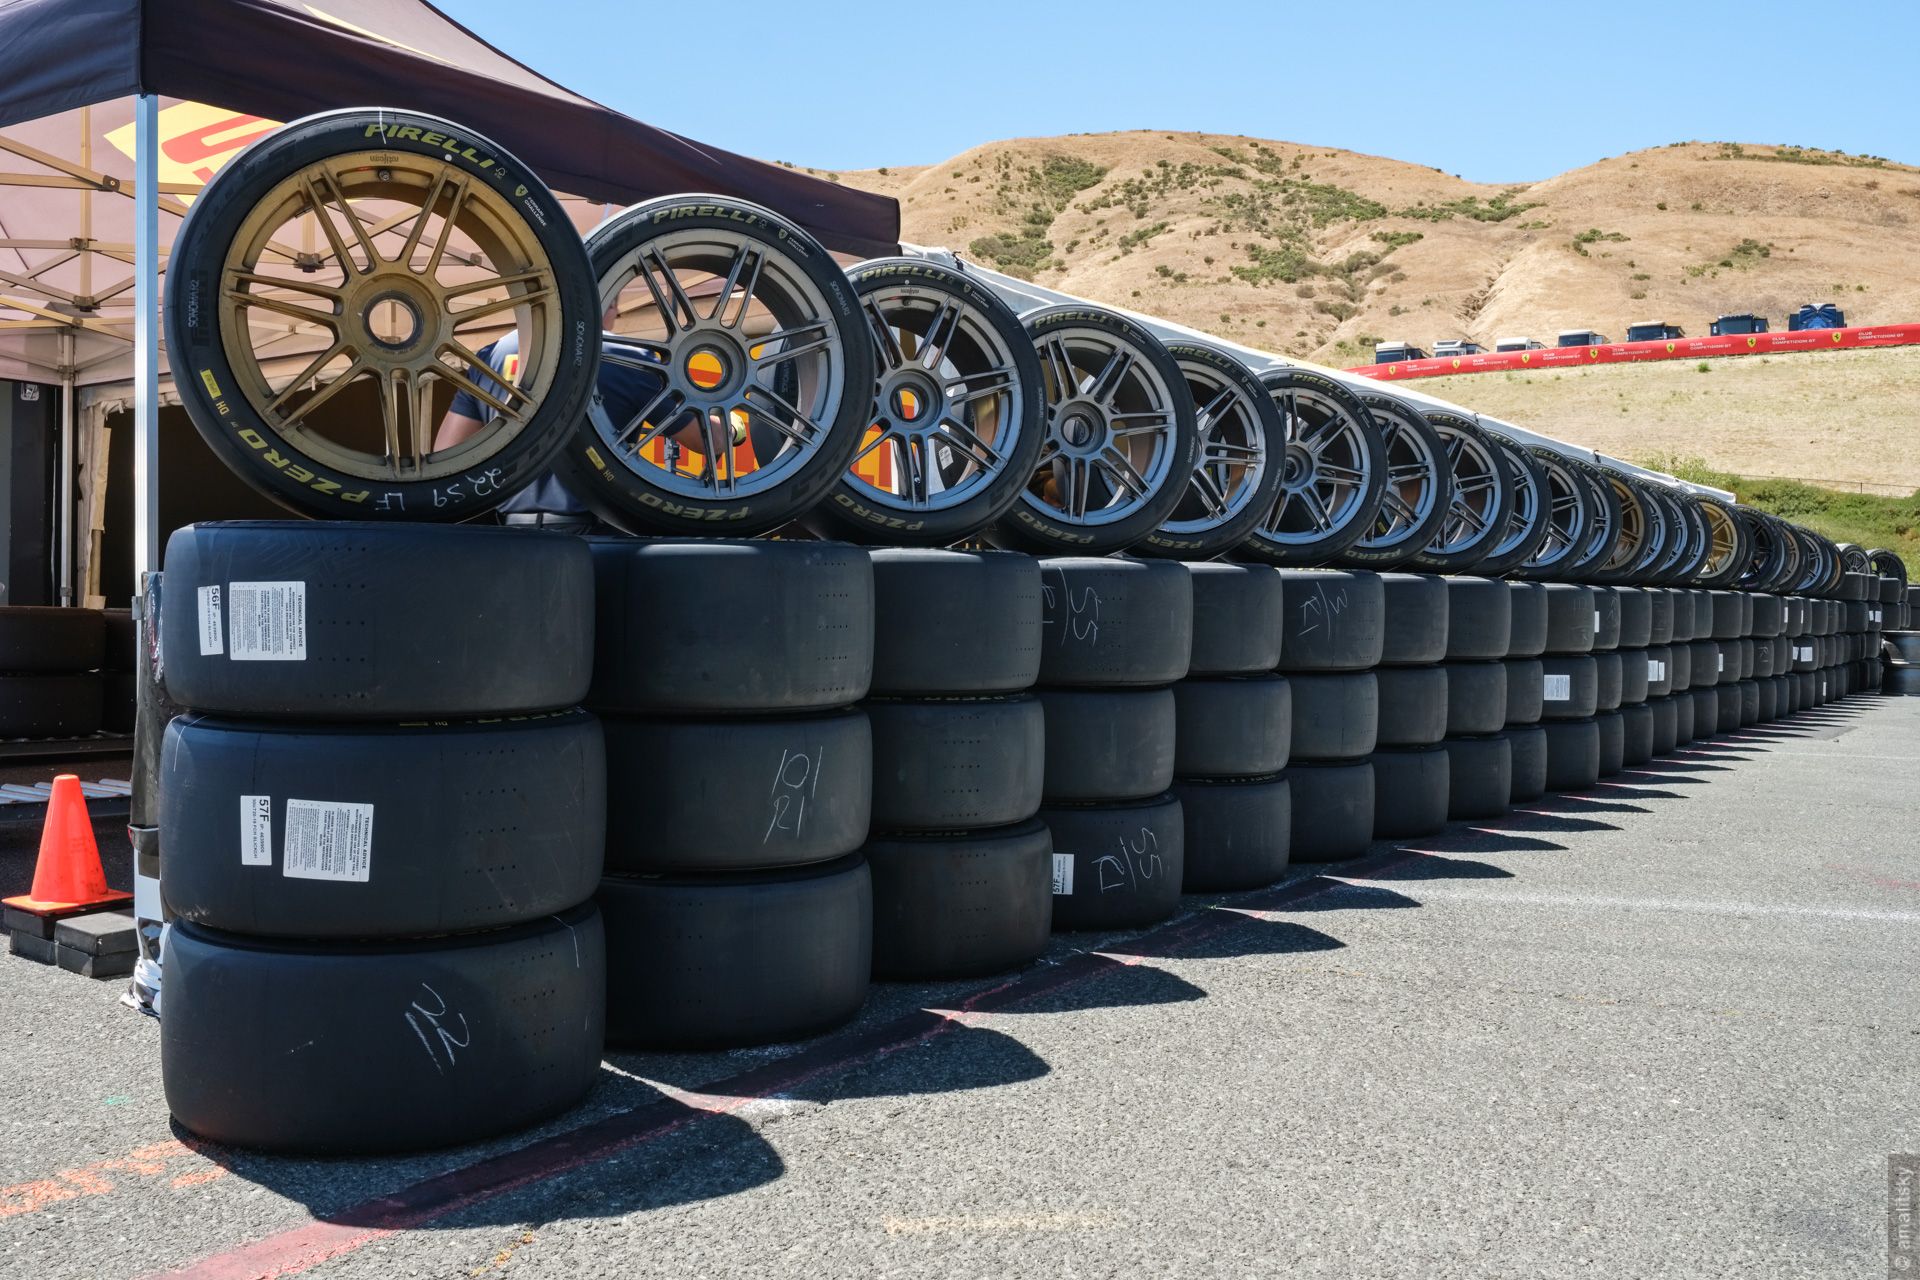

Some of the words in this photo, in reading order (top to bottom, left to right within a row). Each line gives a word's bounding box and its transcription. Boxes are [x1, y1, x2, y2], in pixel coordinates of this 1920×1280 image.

[364, 123, 494, 170] PIRELLI
[653, 205, 757, 224] PIRELLI
[861, 266, 946, 282] PIRELLI
[1035, 311, 1107, 329] PIRELLI
[1293, 374, 1349, 398] PIRELLI
[239, 429, 367, 503] PZERO
[375, 492, 405, 511] LF
[637, 492, 750, 522] PZERO
[834, 493, 924, 532] PZERO
[1017, 510, 1096, 545] PZERO
[212, 587, 220, 610] 56F
[771, 745, 823, 799] 101
[259, 798, 269, 822] 57F
